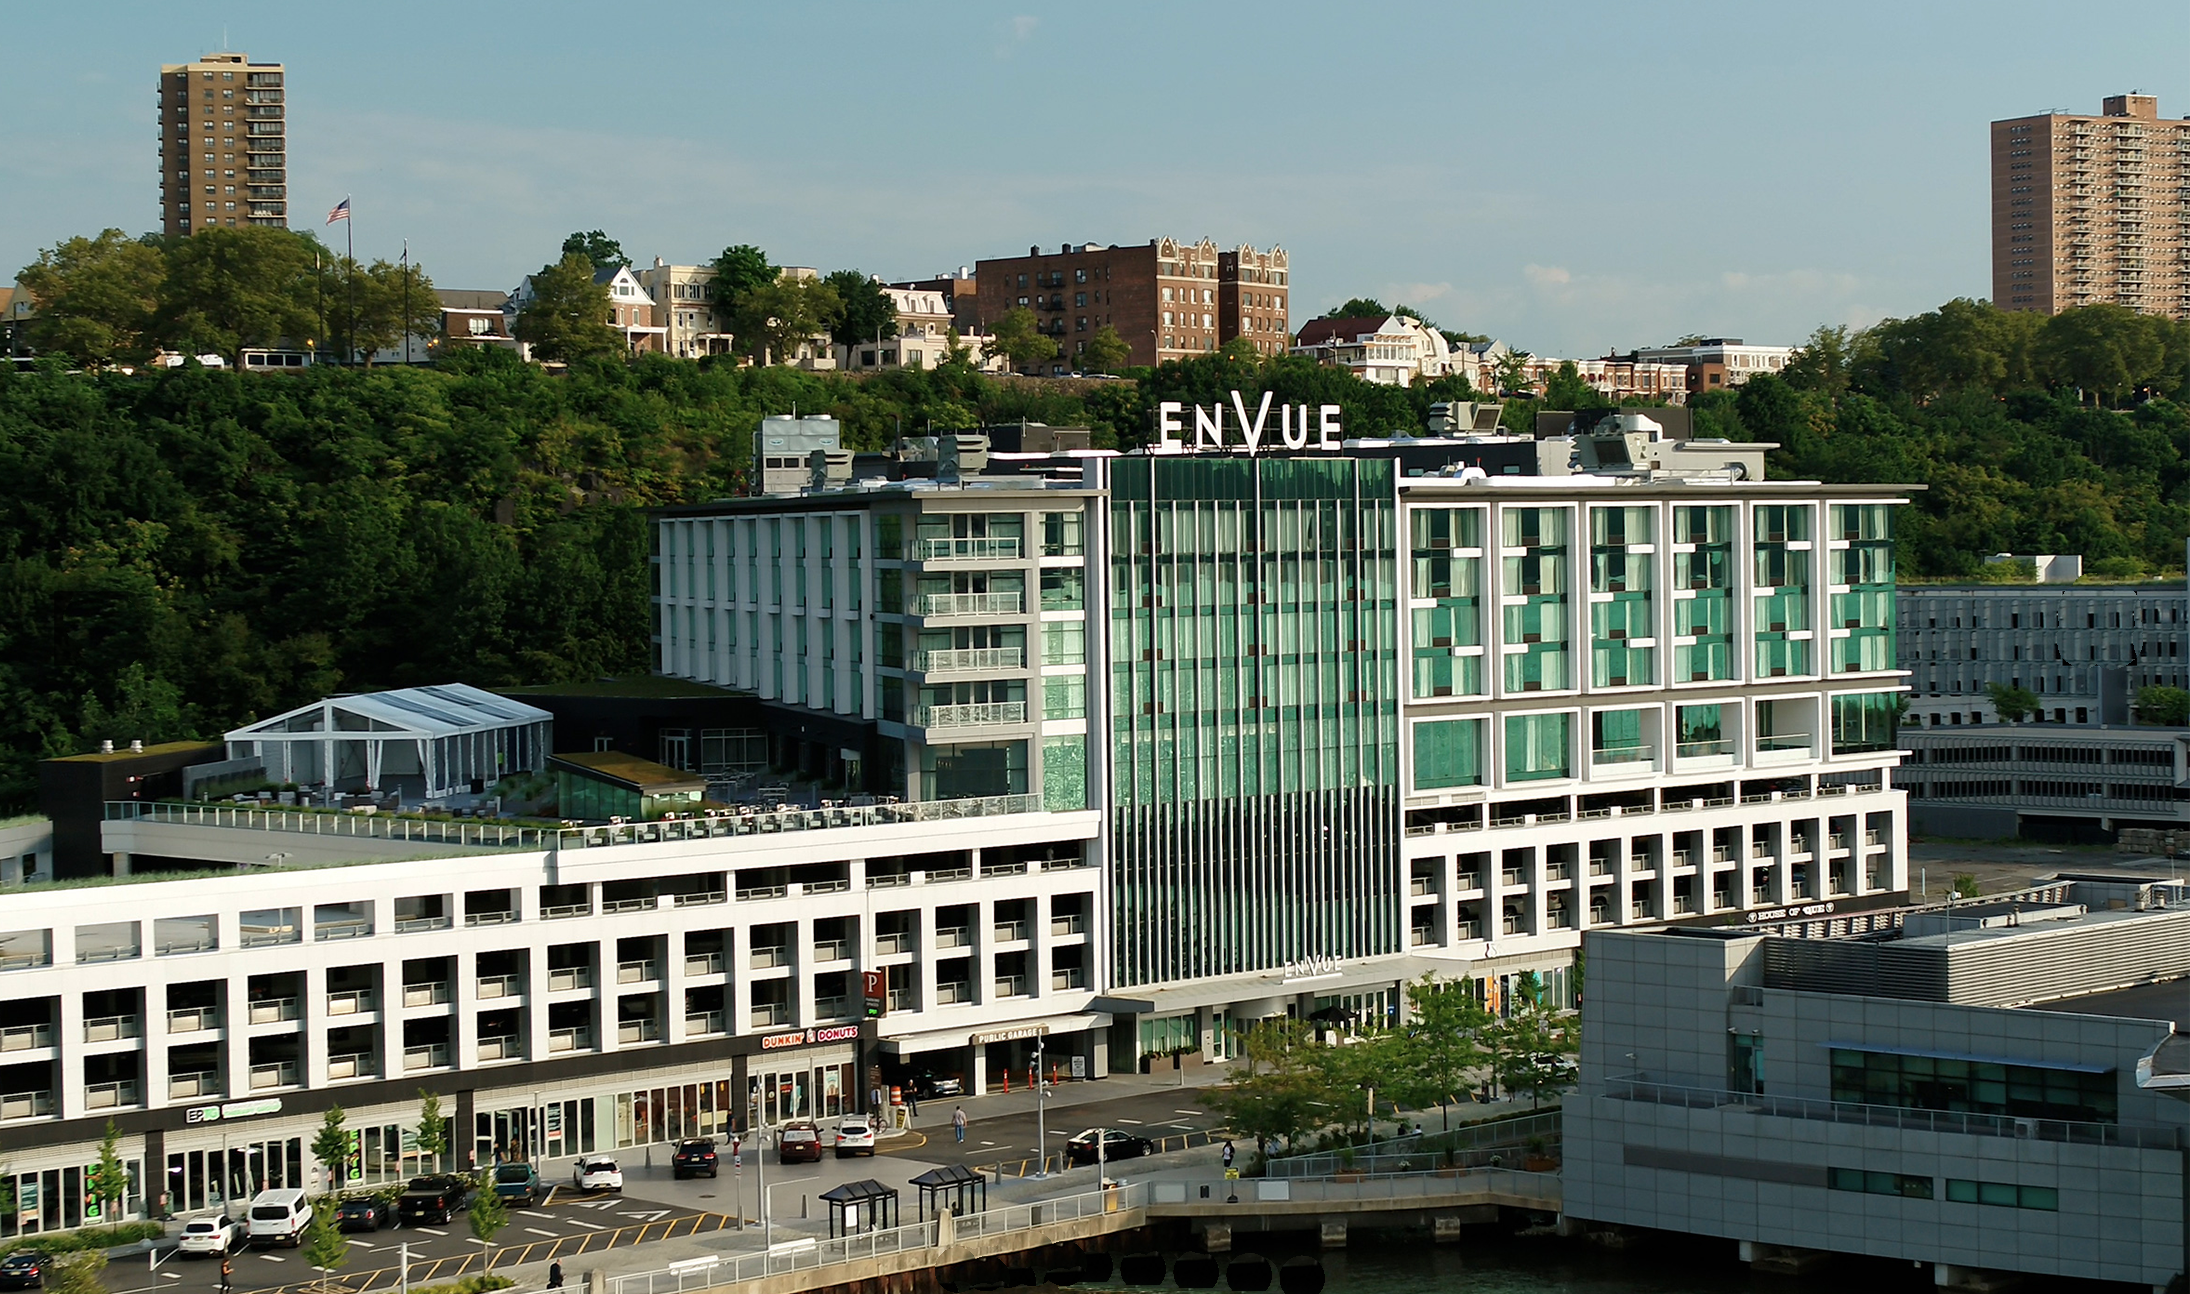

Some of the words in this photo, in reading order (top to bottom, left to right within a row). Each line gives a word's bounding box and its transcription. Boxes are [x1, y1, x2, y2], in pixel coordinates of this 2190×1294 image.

[1160, 390, 1341, 457] ENVUE
[1758, 909, 1786, 920] HOUSE
[1788, 907, 1801, 917] OF
[1284, 954, 1342, 977] ENVUE
[867, 974, 878, 993] P
[762, 1032, 805, 1049] DUNKIN'
[818, 1026, 858, 1041] DONUTS
[979, 1032, 1007, 1044] PUBLIC
[1007, 1028, 1038, 1040] GARAGE
